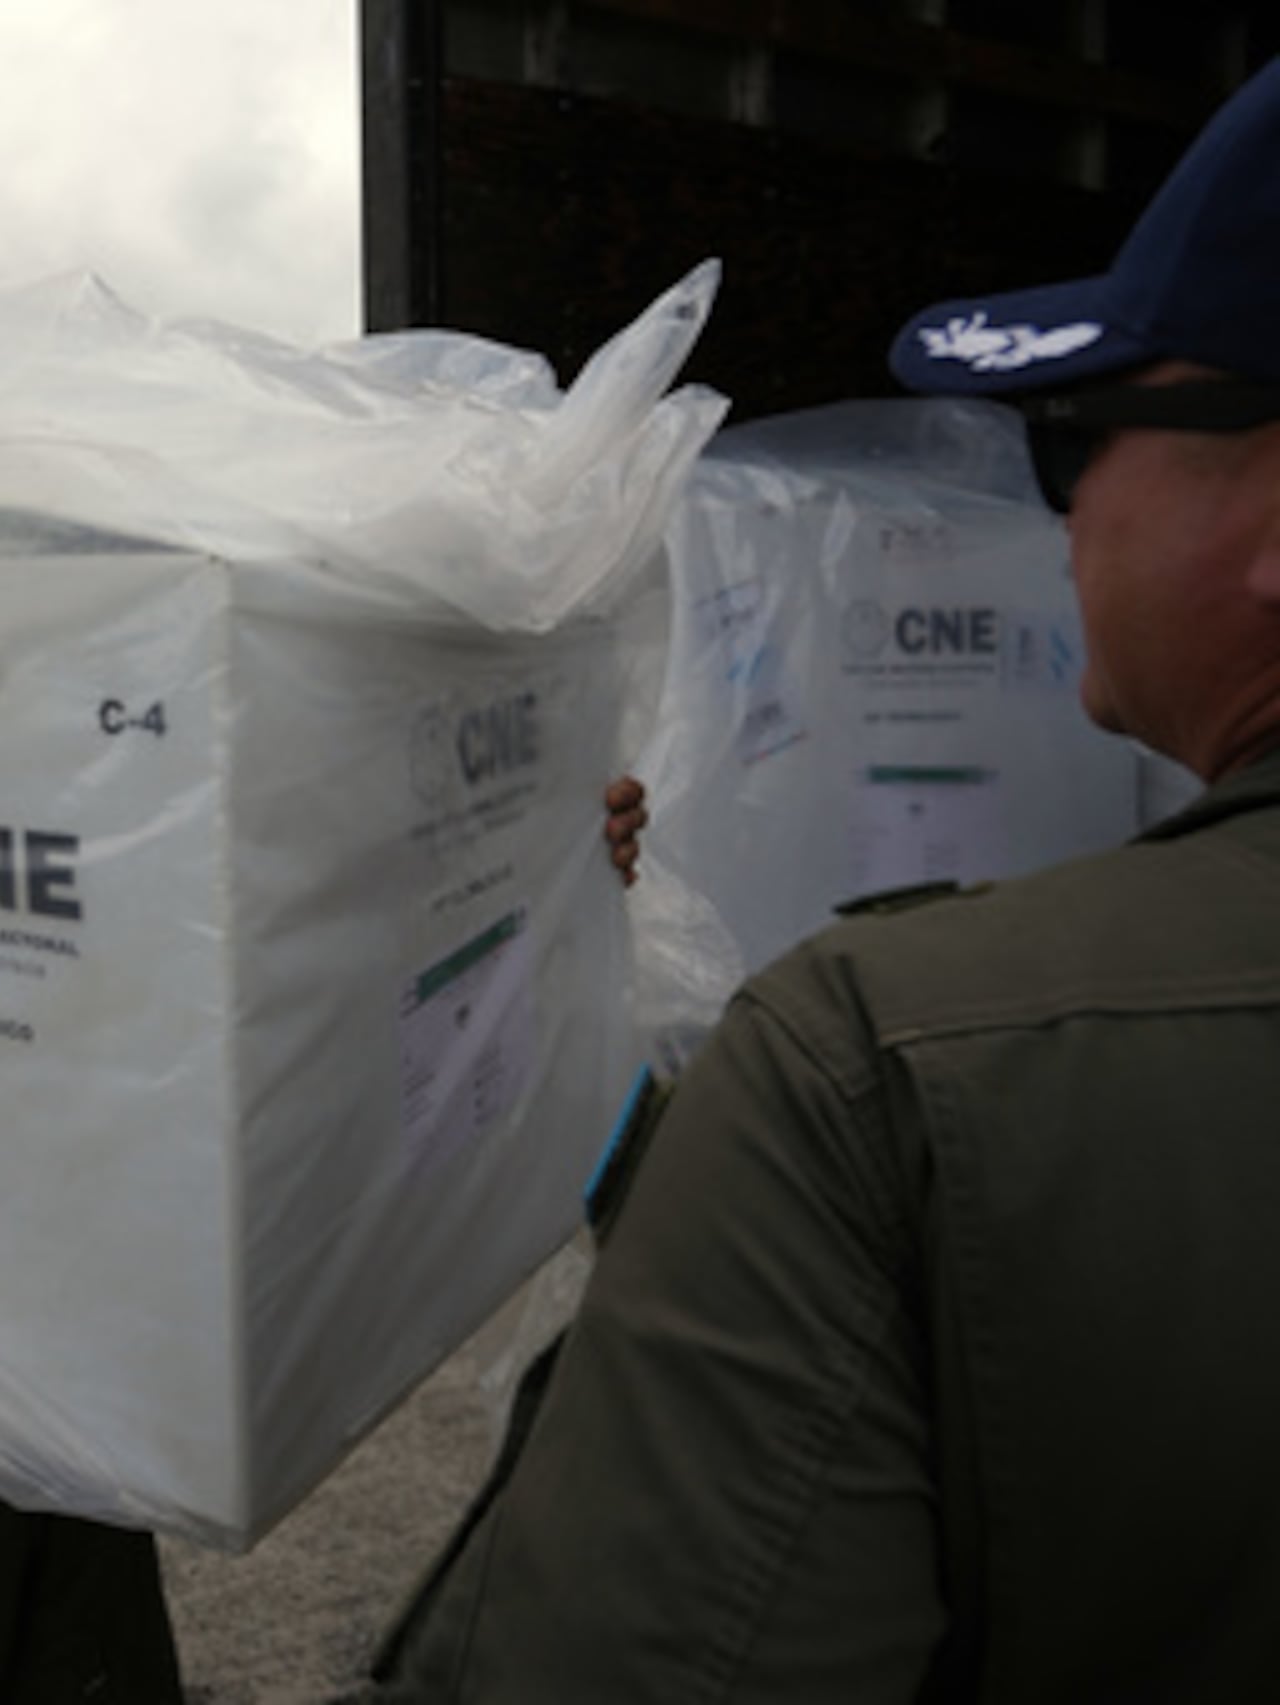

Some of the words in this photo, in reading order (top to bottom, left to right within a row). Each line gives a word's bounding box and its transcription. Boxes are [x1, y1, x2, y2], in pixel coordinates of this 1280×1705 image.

[895, 607, 997, 655] CNE
[98, 698, 167, 737] C-4
[457, 692, 539, 787] CNE
